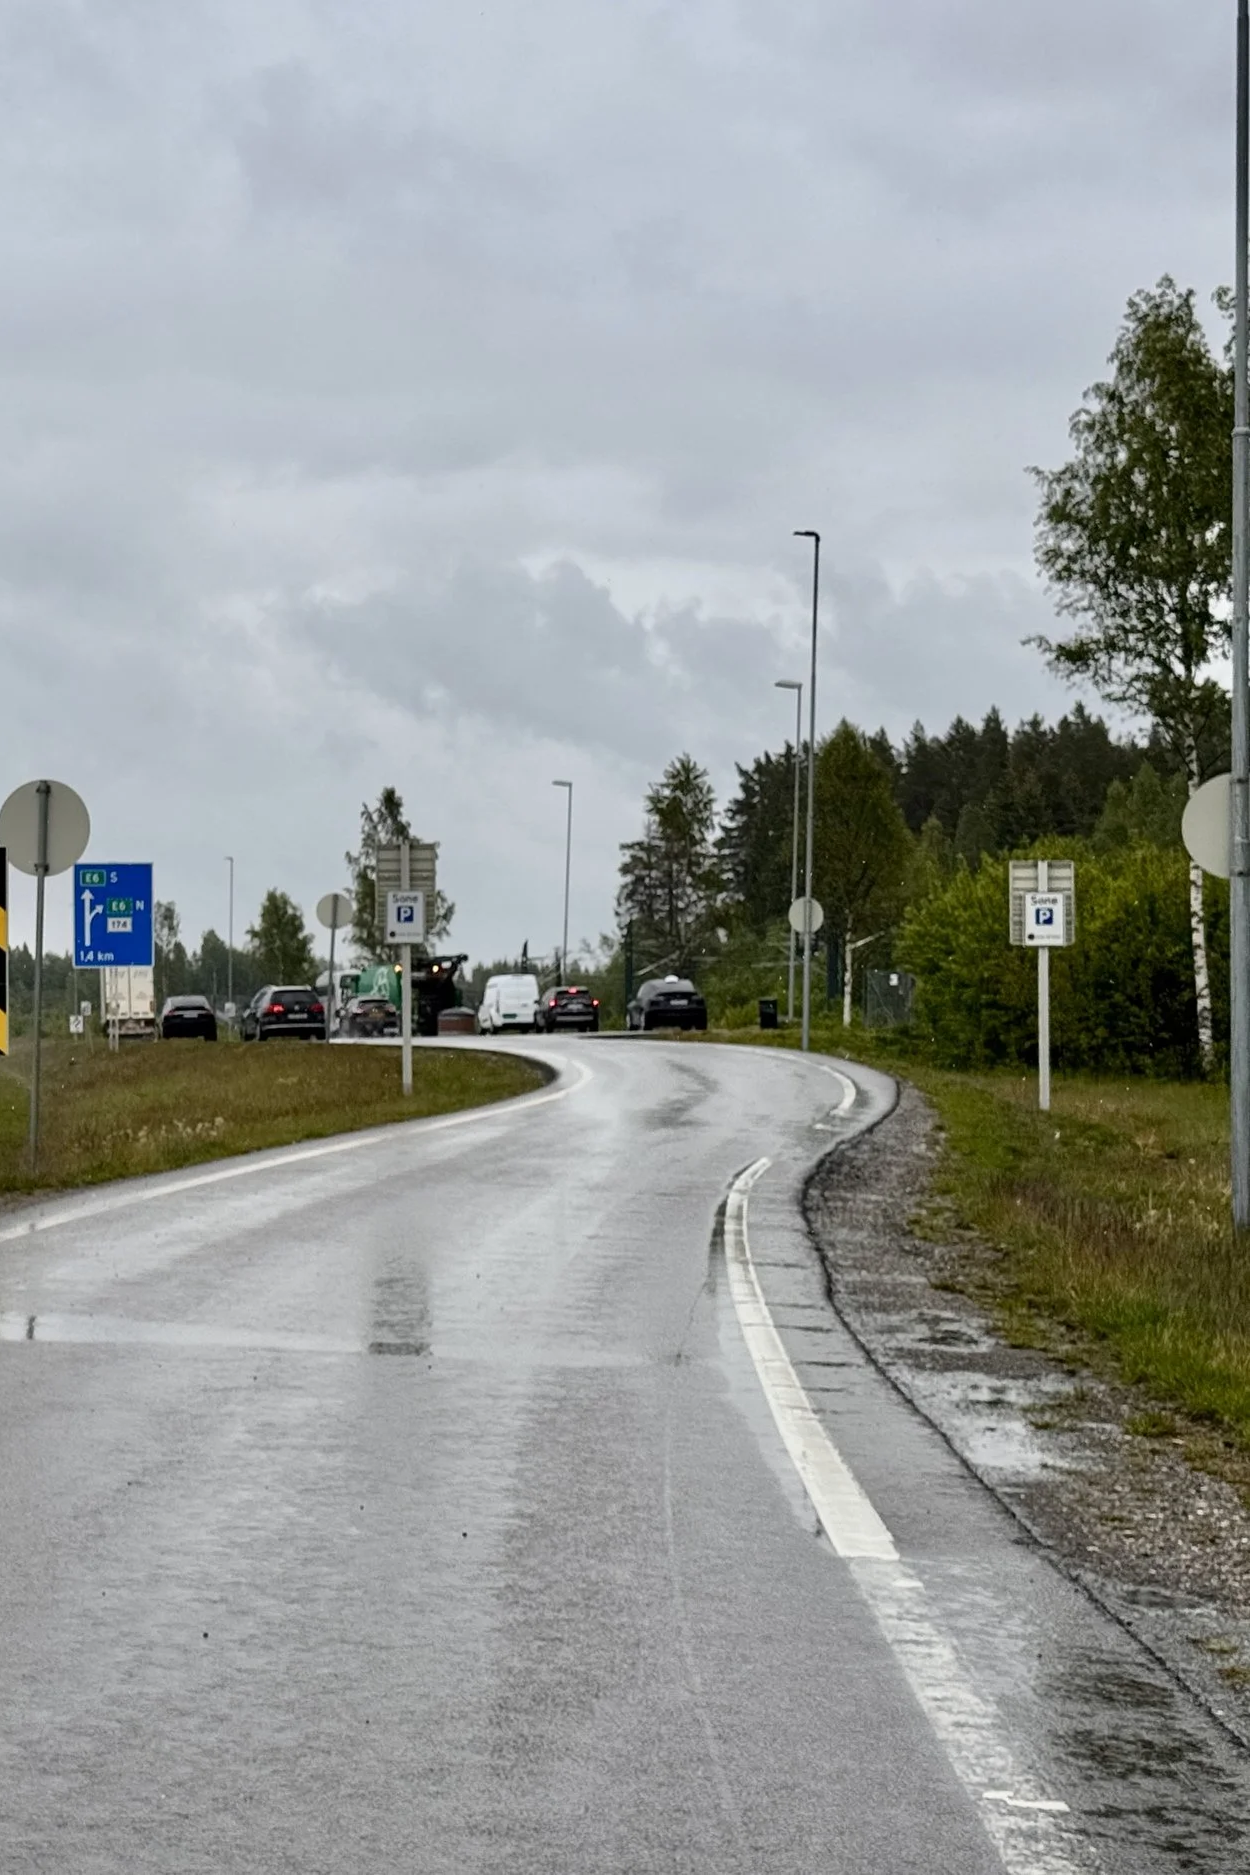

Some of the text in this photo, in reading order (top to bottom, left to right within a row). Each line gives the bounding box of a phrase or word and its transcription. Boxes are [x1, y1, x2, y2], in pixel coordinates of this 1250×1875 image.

[86, 871, 118, 883] E6 S
[393, 894, 418, 903] Sone
[1031, 896, 1058, 905] Sone
[112, 900, 144, 911] E6 N
[111, 920, 127, 929] 174
[97, 951, 114, 961] km
